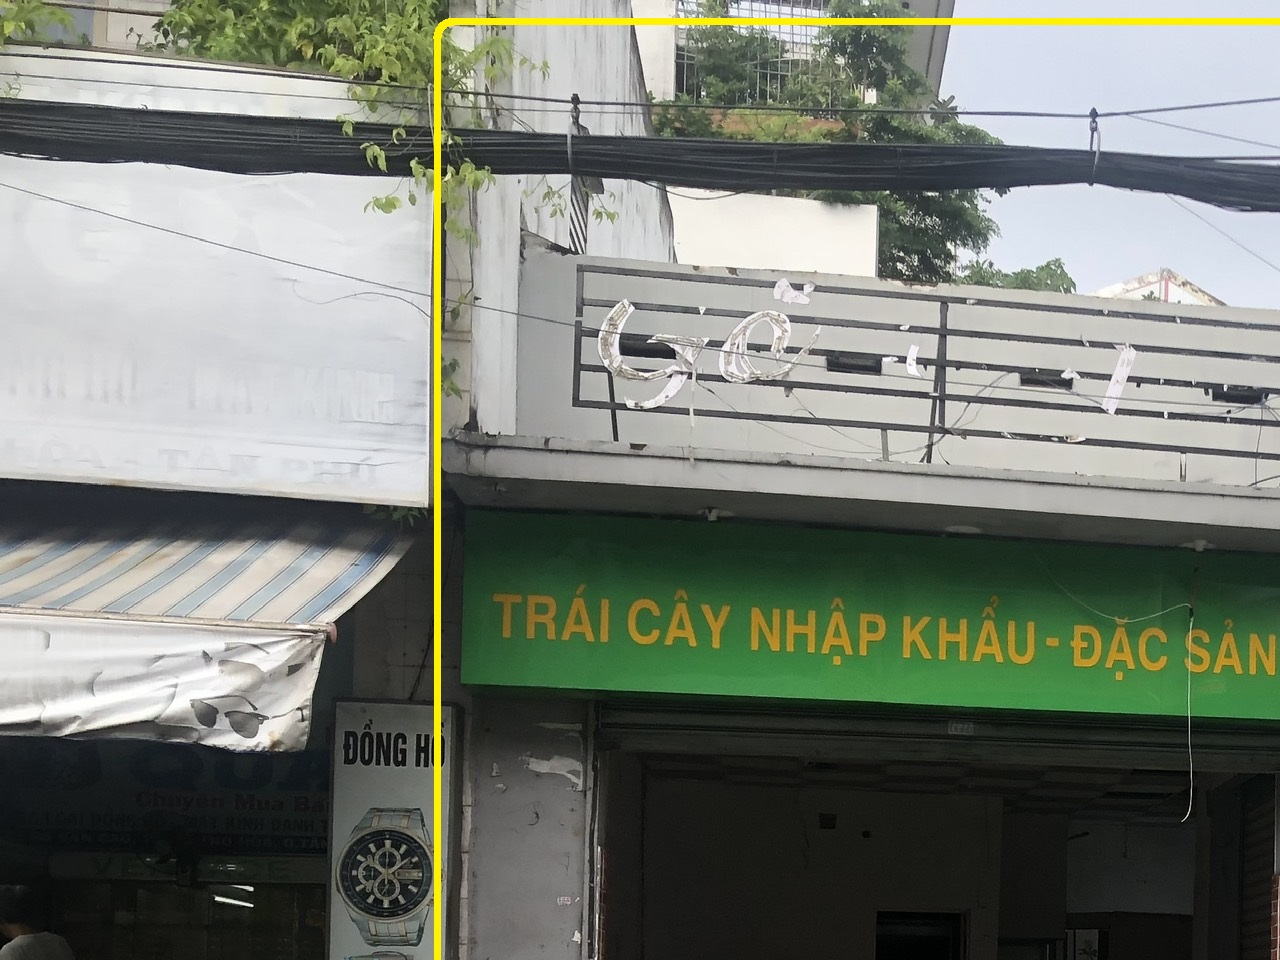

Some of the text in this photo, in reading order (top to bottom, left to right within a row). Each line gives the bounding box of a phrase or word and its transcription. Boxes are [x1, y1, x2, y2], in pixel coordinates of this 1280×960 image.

[494, 584, 610, 643] TRÁI
[627, 589, 731, 649] CÂY
[750, 597, 887, 666] NHẬP
[902, 595, 1036, 666] KHẨU
[1070, 615, 1168, 681] ĐẶC
[1184, 618, 1276, 677] SẢN
[343, 719, 407, 767] ĐỒNG
